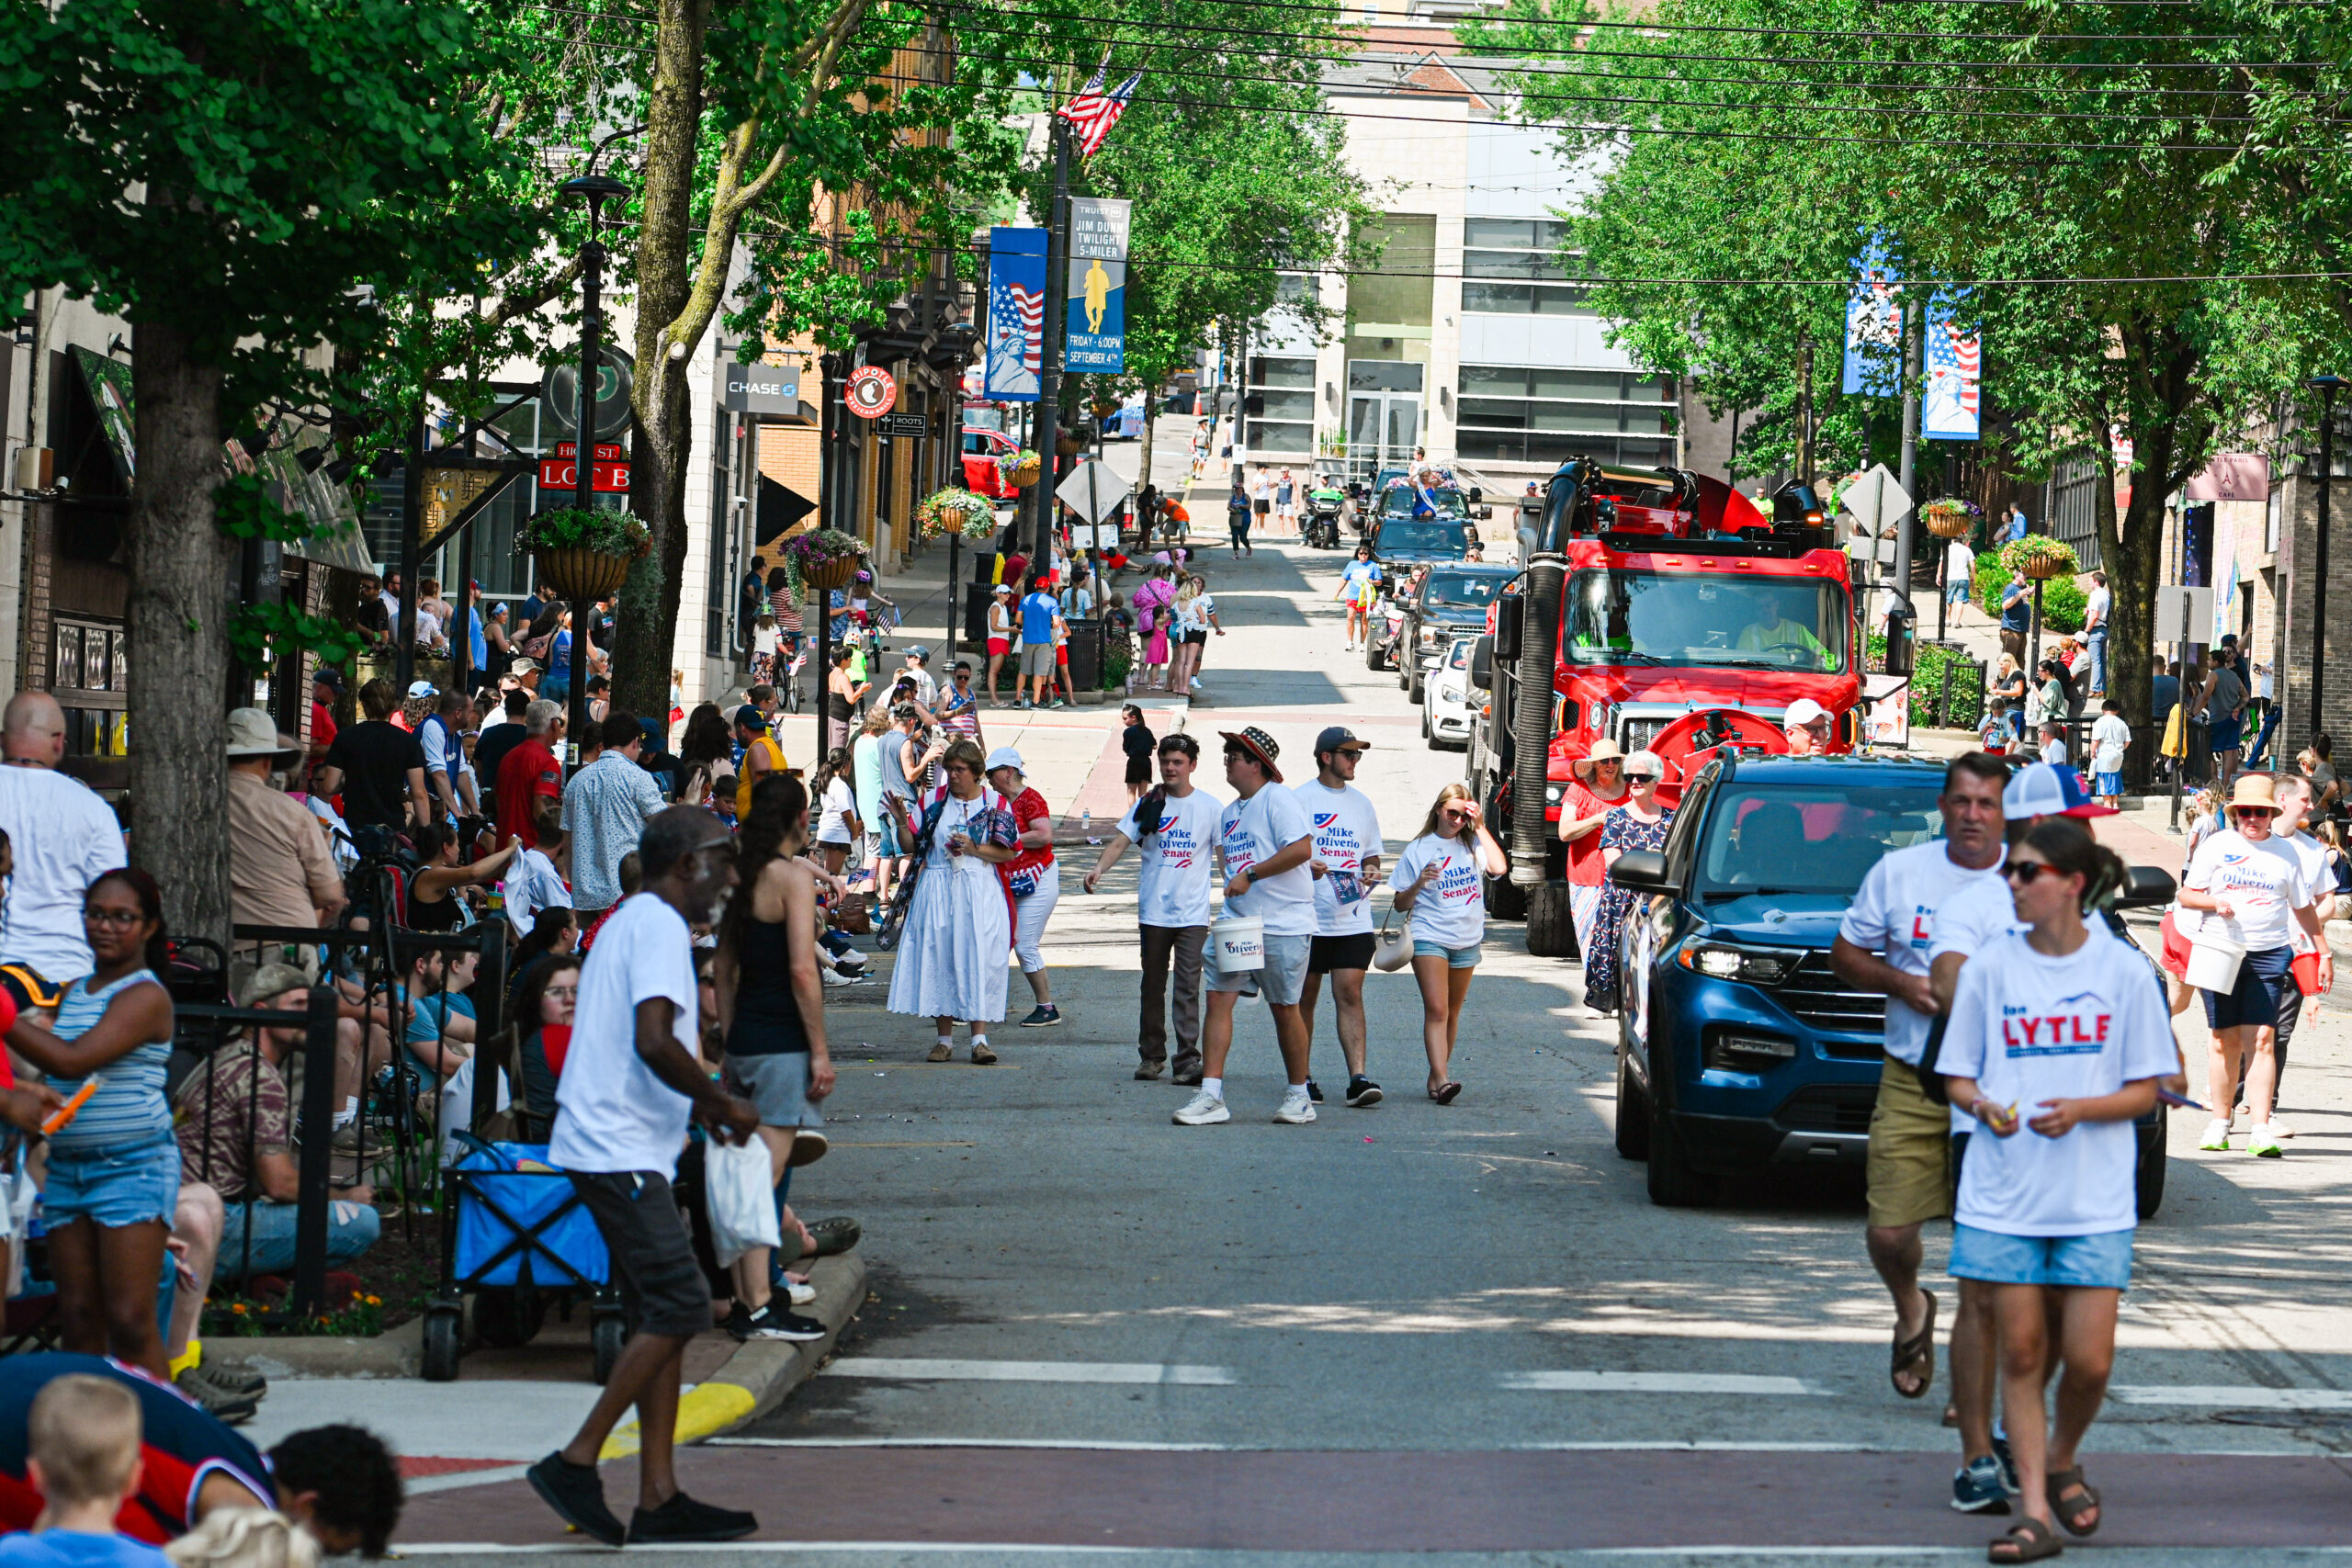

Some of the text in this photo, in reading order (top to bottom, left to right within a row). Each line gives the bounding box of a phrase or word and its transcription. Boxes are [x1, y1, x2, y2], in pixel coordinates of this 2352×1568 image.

[1080, 206, 1110, 215] TRUIST
[1075, 220, 1124, 233] JIM DUNN
[1077, 232, 1121, 245] TWILIGHT
[1080, 245, 1118, 257] 5-MILER
[1069, 334, 1093, 347] FRIDAY
[1097, 336, 1121, 348] 6:00PM
[1069, 351, 1105, 364] SEPTEMBER
[847, 367, 894, 389] CHIPOTLE
[729, 381, 780, 396] CHASE
[847, 395, 875, 415] MEXICAN
[896, 417, 922, 425] ROOTS
[597, 447, 617, 458] ST.
[612, 468, 630, 487] B
[1168, 829, 1192, 839] Mike
[1228, 831, 1249, 843] Mike
[1327, 827, 1354, 838] Mike
[1223, 840, 1256, 855] Oliverio
[1316, 837, 1360, 849] Oliverio
[1225, 852, 1252, 865] Senate
[1319, 847, 1356, 858] Senate
[1443, 866, 1471, 879] Mike
[2236, 866, 2267, 879] Mike
[1437, 873, 1478, 890] Oliverio
[2222, 873, 2275, 890] Oliverio
[1442, 884, 1478, 900] Senate
[2002, 1013, 2112, 1047] LYTLE
